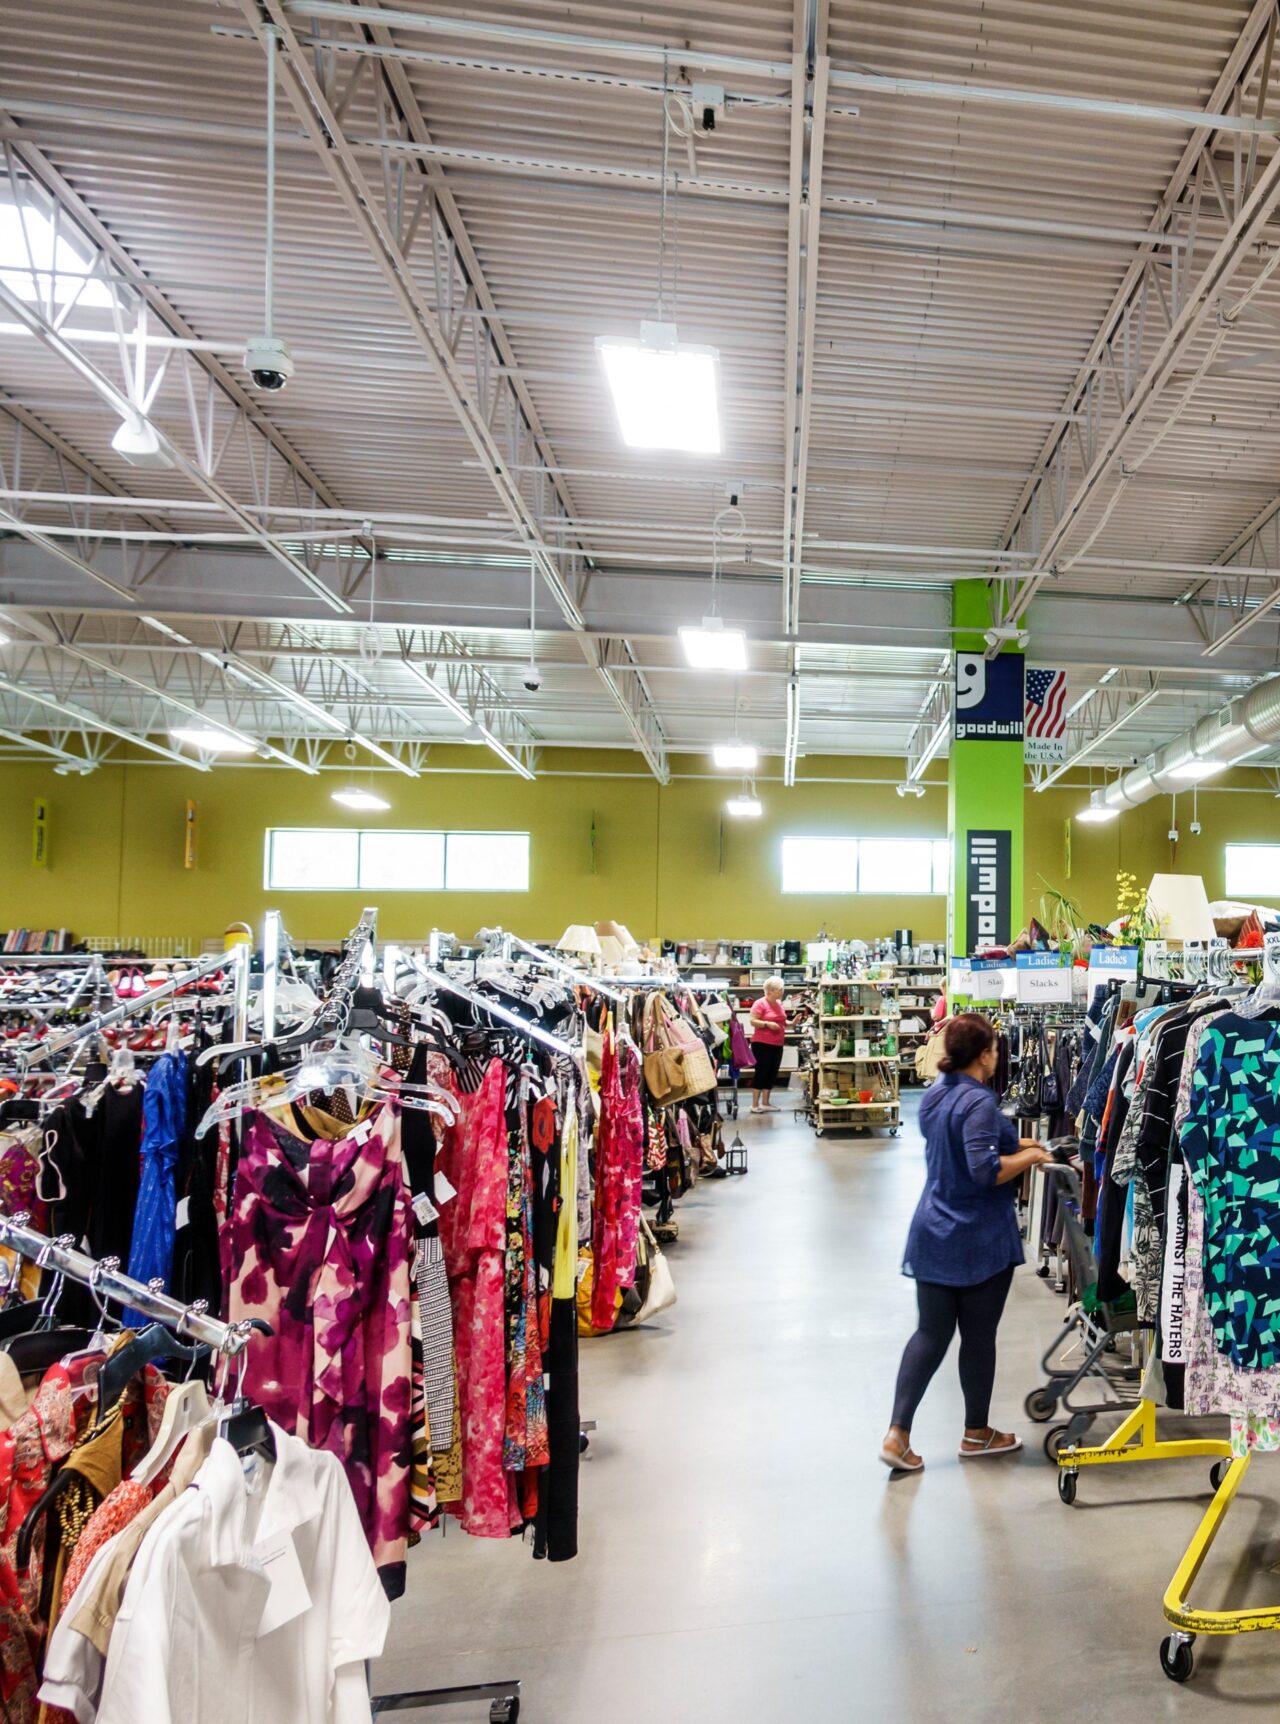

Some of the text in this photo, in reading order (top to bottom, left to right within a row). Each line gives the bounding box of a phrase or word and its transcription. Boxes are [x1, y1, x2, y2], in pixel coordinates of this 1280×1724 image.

[957, 721, 1024, 738] goodwill
[1028, 742, 1051, 750] Made
[980, 961, 1007, 969] Ladies
[1099, 951, 1127, 965] Ladies
[1030, 979, 1059, 987] Slacks
[1171, 1273, 1185, 1298] THE
[1169, 1302, 1183, 1359] HATERS
